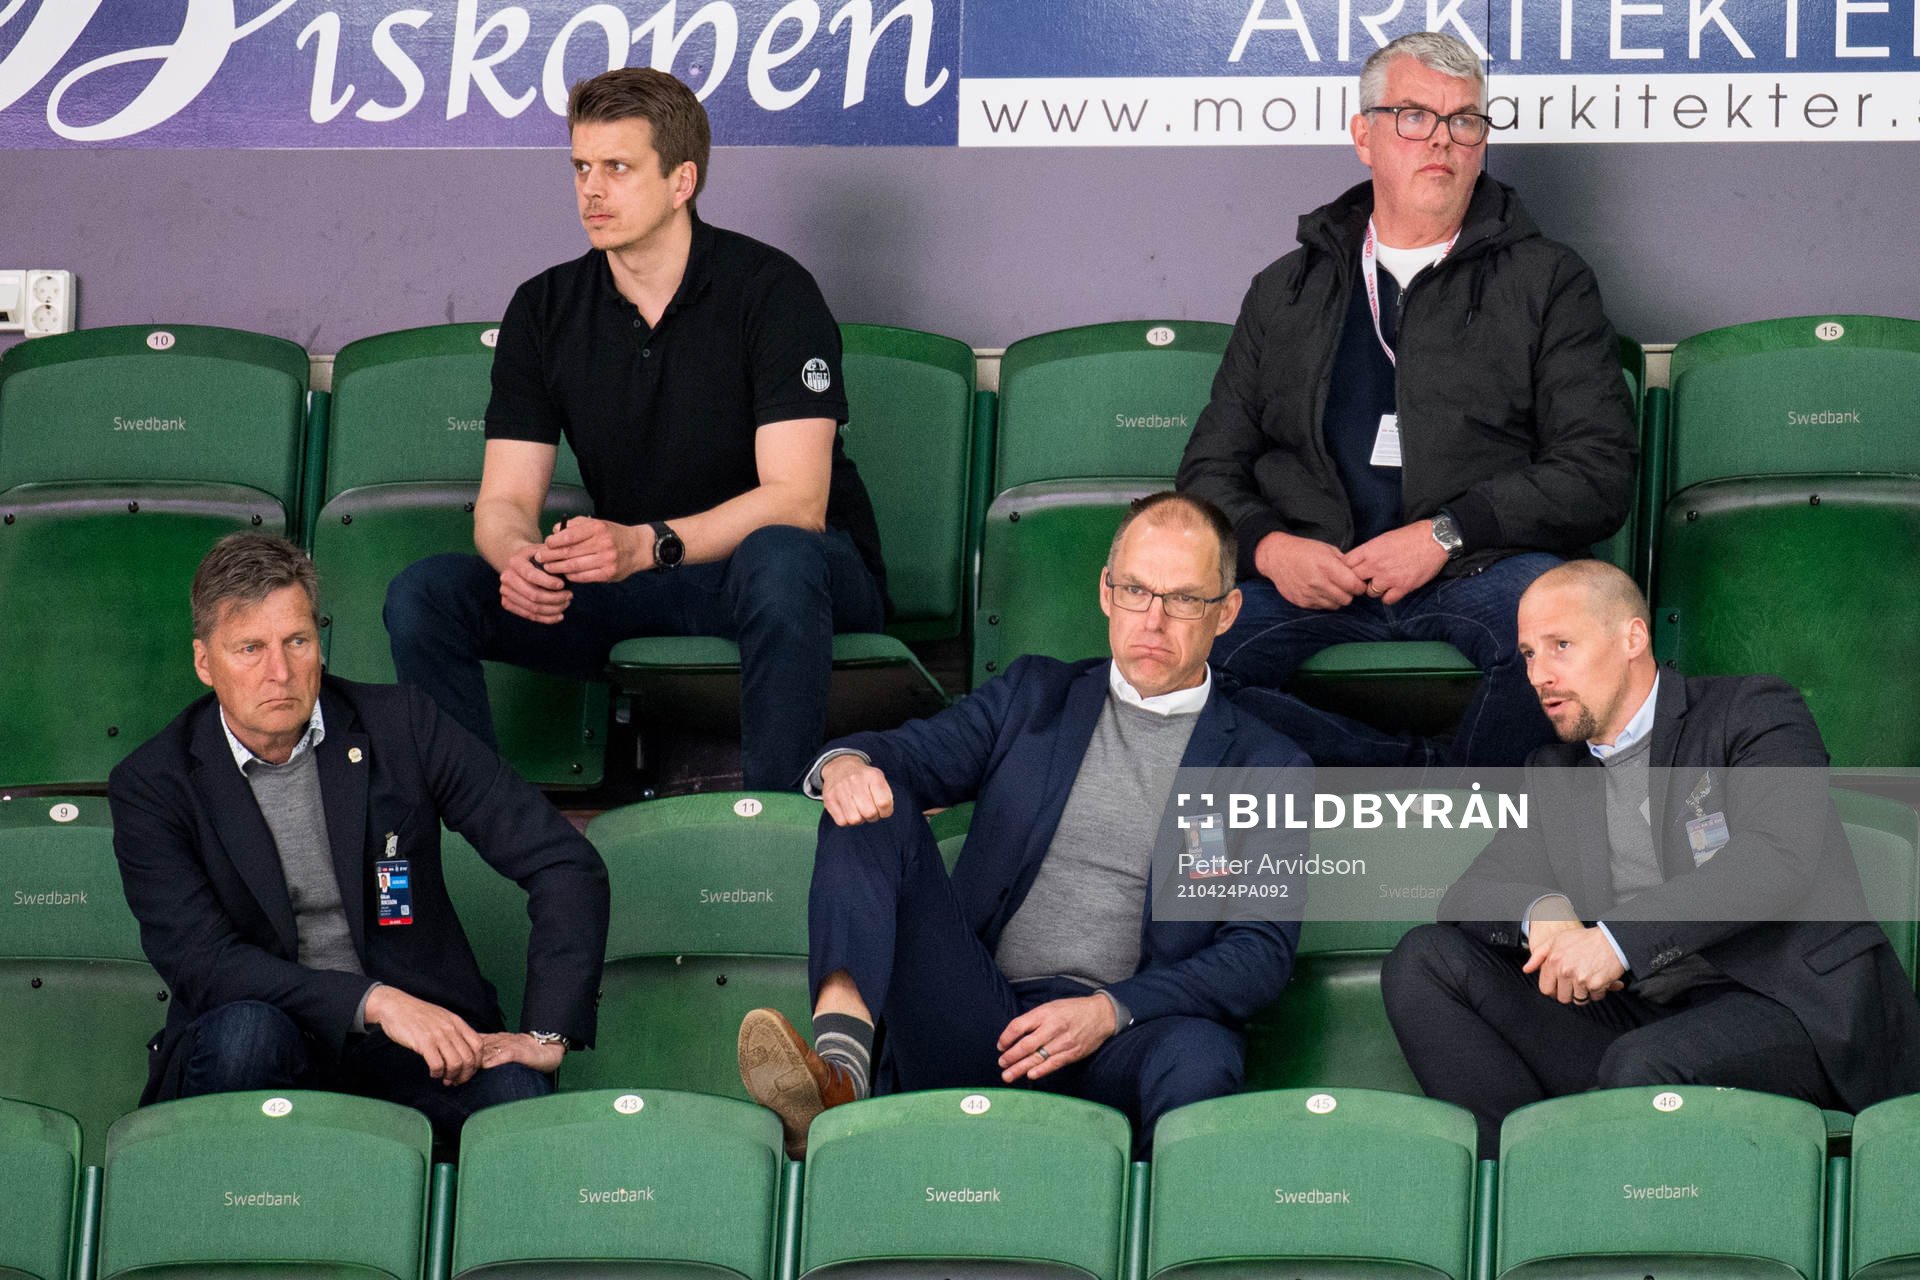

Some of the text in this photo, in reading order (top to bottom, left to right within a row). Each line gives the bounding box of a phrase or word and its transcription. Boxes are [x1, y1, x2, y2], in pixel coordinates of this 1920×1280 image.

[1153, 331, 1168, 342] 13
[1822, 326, 1838, 337] 15
[154, 335, 169, 346] 10
[113, 416, 187, 431] Swedbank
[1115, 413, 1188, 428] Swedbank
[1788, 410, 1863, 425] Swedbank
[60, 807, 68, 818] 9
[743, 803, 755, 813] 11
[14, 890, 89, 905] Swedbank
[700, 888, 776, 903] Swedbank
[269, 1102, 286, 1113] 42
[621, 1099, 637, 1110] 43
[967, 1099, 983, 1110] 44
[1313, 1099, 1330, 1109] 45
[1660, 1096, 1676, 1107] 46
[580, 1186, 654, 1203] Swedbank
[926, 1187, 1002, 1203] Swedbank
[1275, 1188, 1351, 1204] Swedbank
[1623, 1183, 1699, 1199] Swedbank
[224, 1191, 301, 1207] Swedbank
